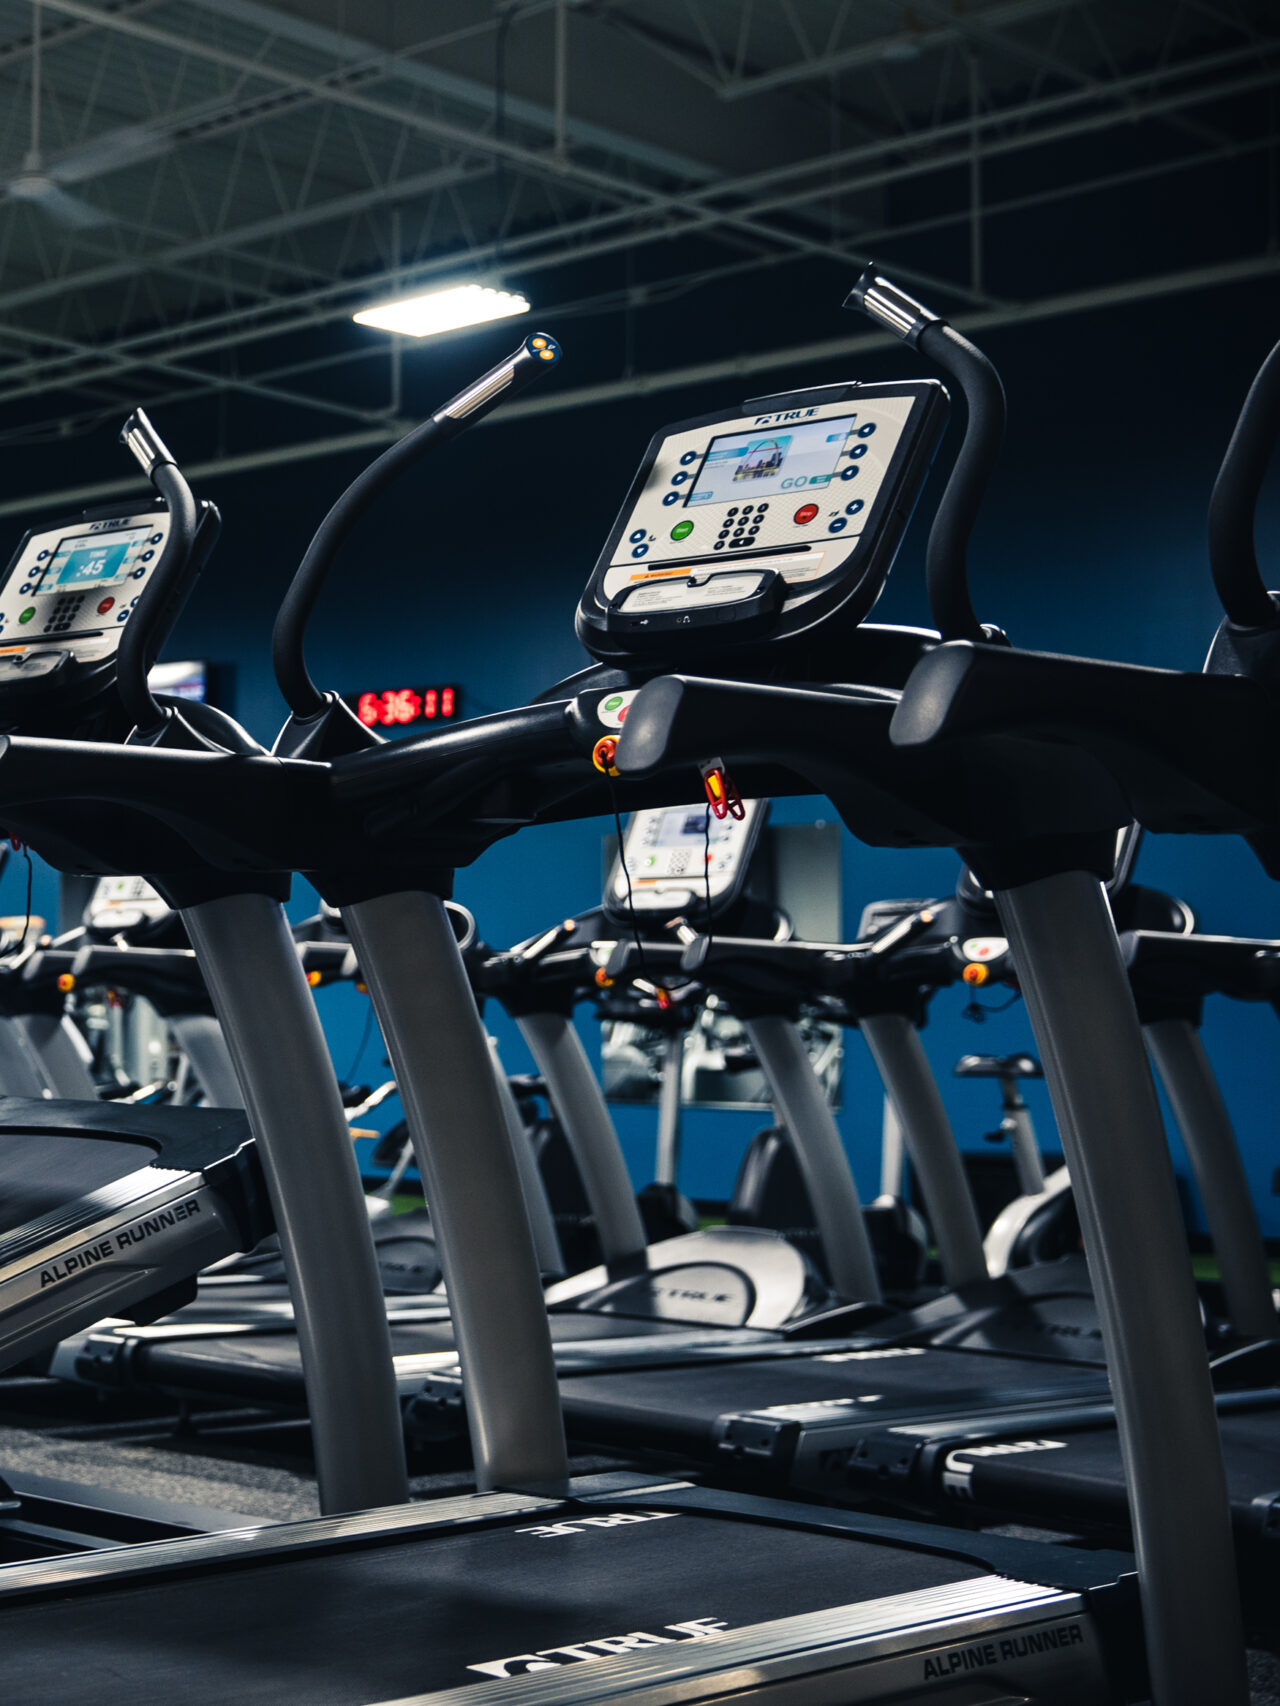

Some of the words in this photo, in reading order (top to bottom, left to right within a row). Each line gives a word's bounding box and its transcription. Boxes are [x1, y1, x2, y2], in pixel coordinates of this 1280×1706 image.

[771, 407, 819, 422] TRUE
[781, 475, 808, 489] GO
[40, 1240, 115, 1288] ALPINE
[116, 1199, 201, 1250] RUNNER
[923, 1644, 998, 1681] ALPINE
[1000, 1624, 1084, 1661] RUNNER
